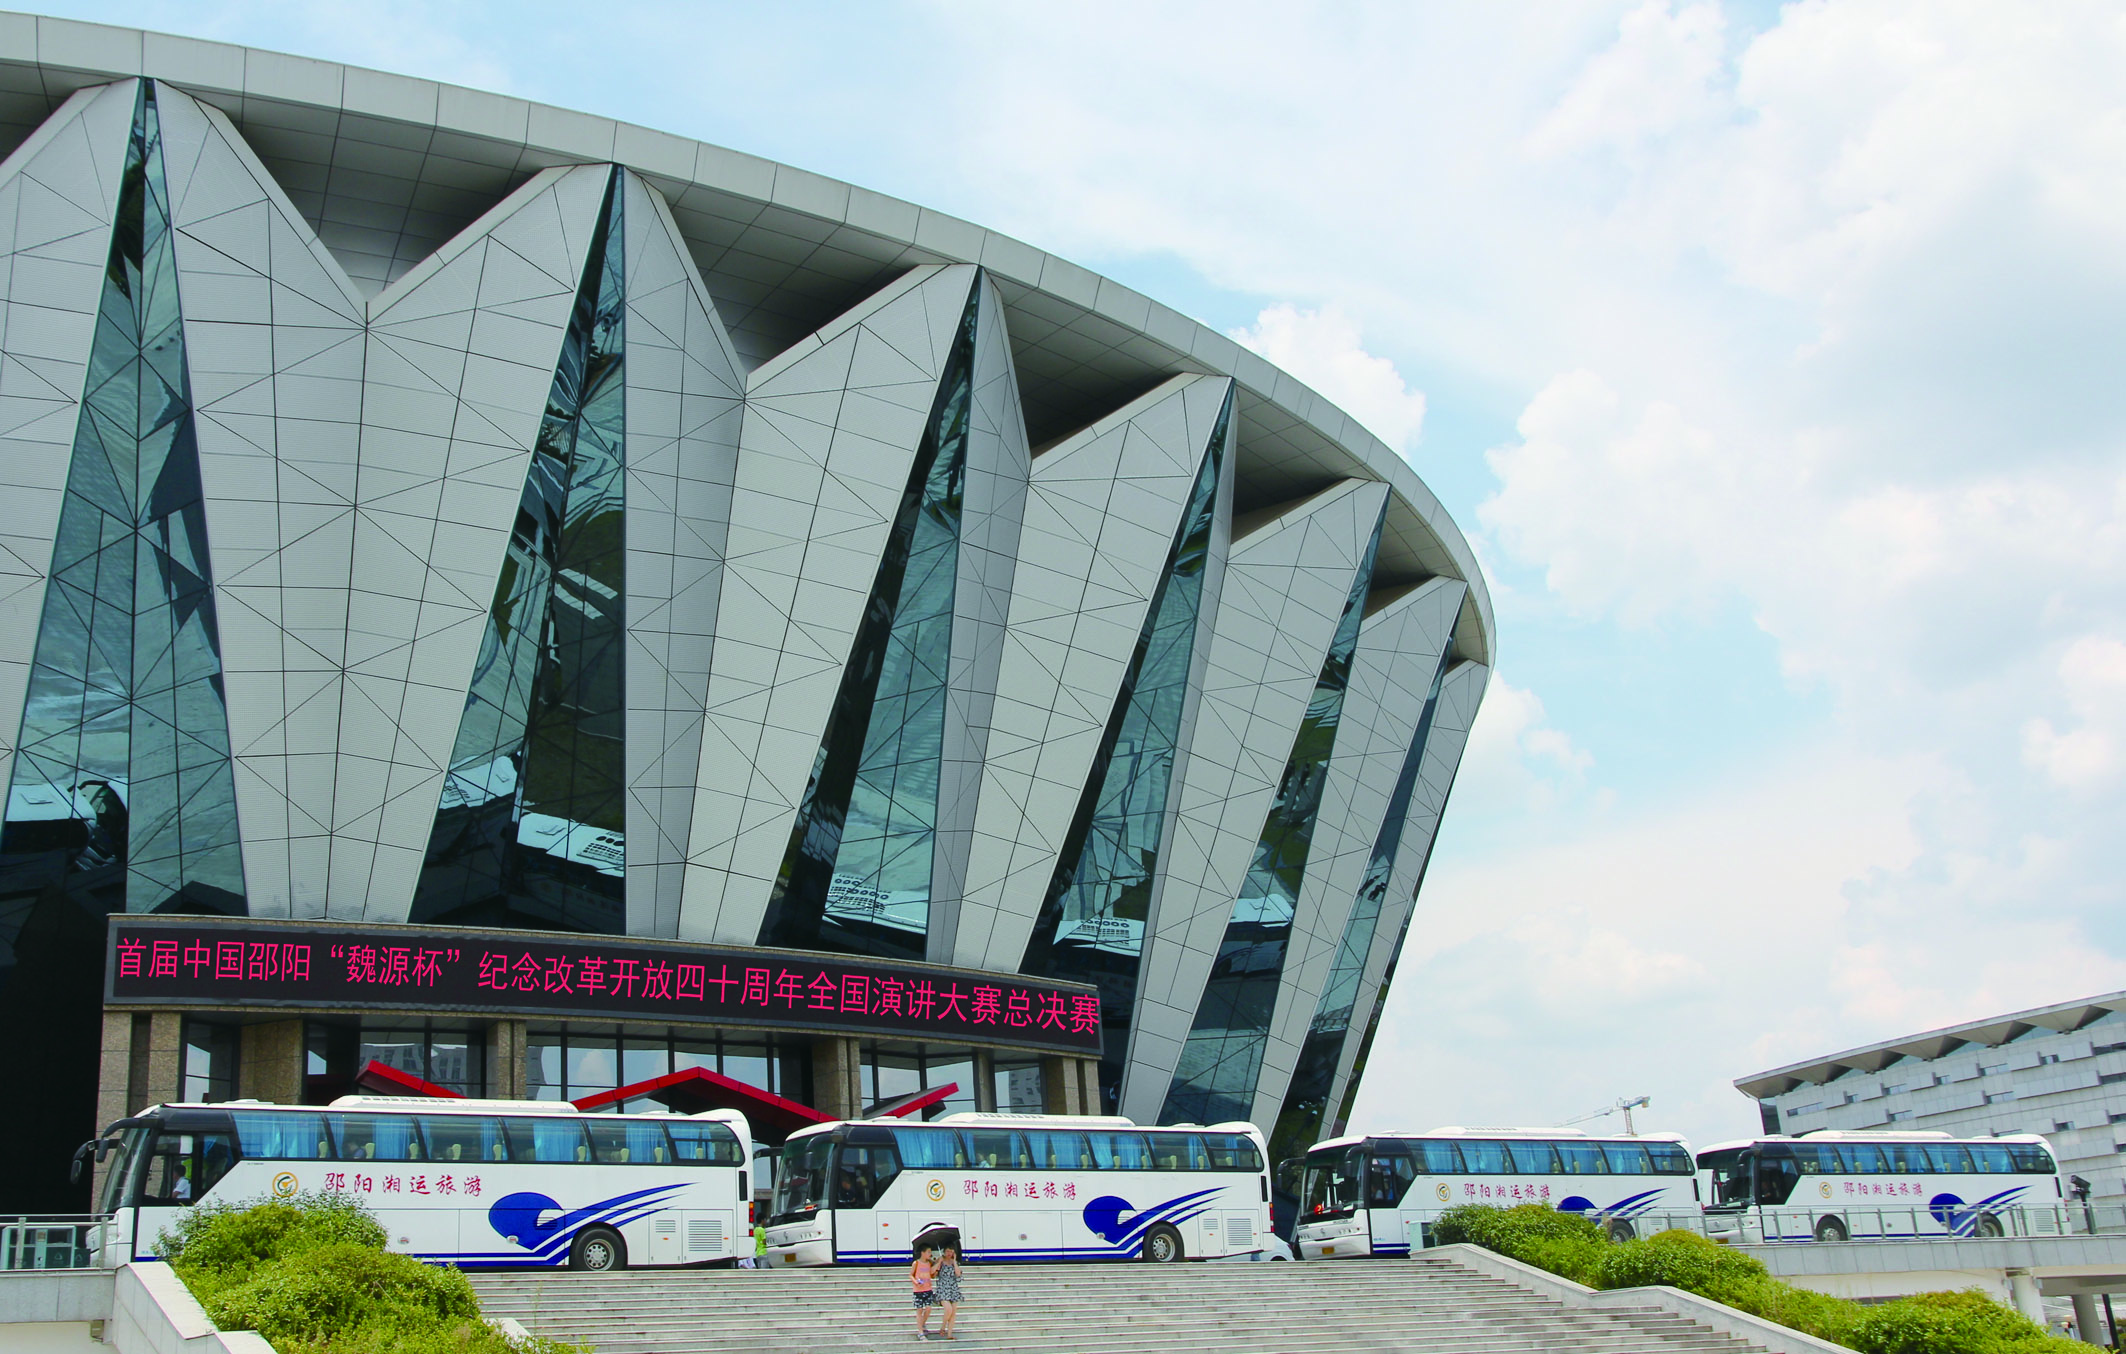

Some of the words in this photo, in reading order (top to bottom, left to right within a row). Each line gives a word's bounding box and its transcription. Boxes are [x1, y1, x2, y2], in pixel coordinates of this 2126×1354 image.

[324, 1172, 482, 1197] 邵阳湘运旅游
[963, 1179, 1077, 1201] 邵阳湘运旅游
[1464, 1183, 1550, 1200] 邵阳湘运旅游
